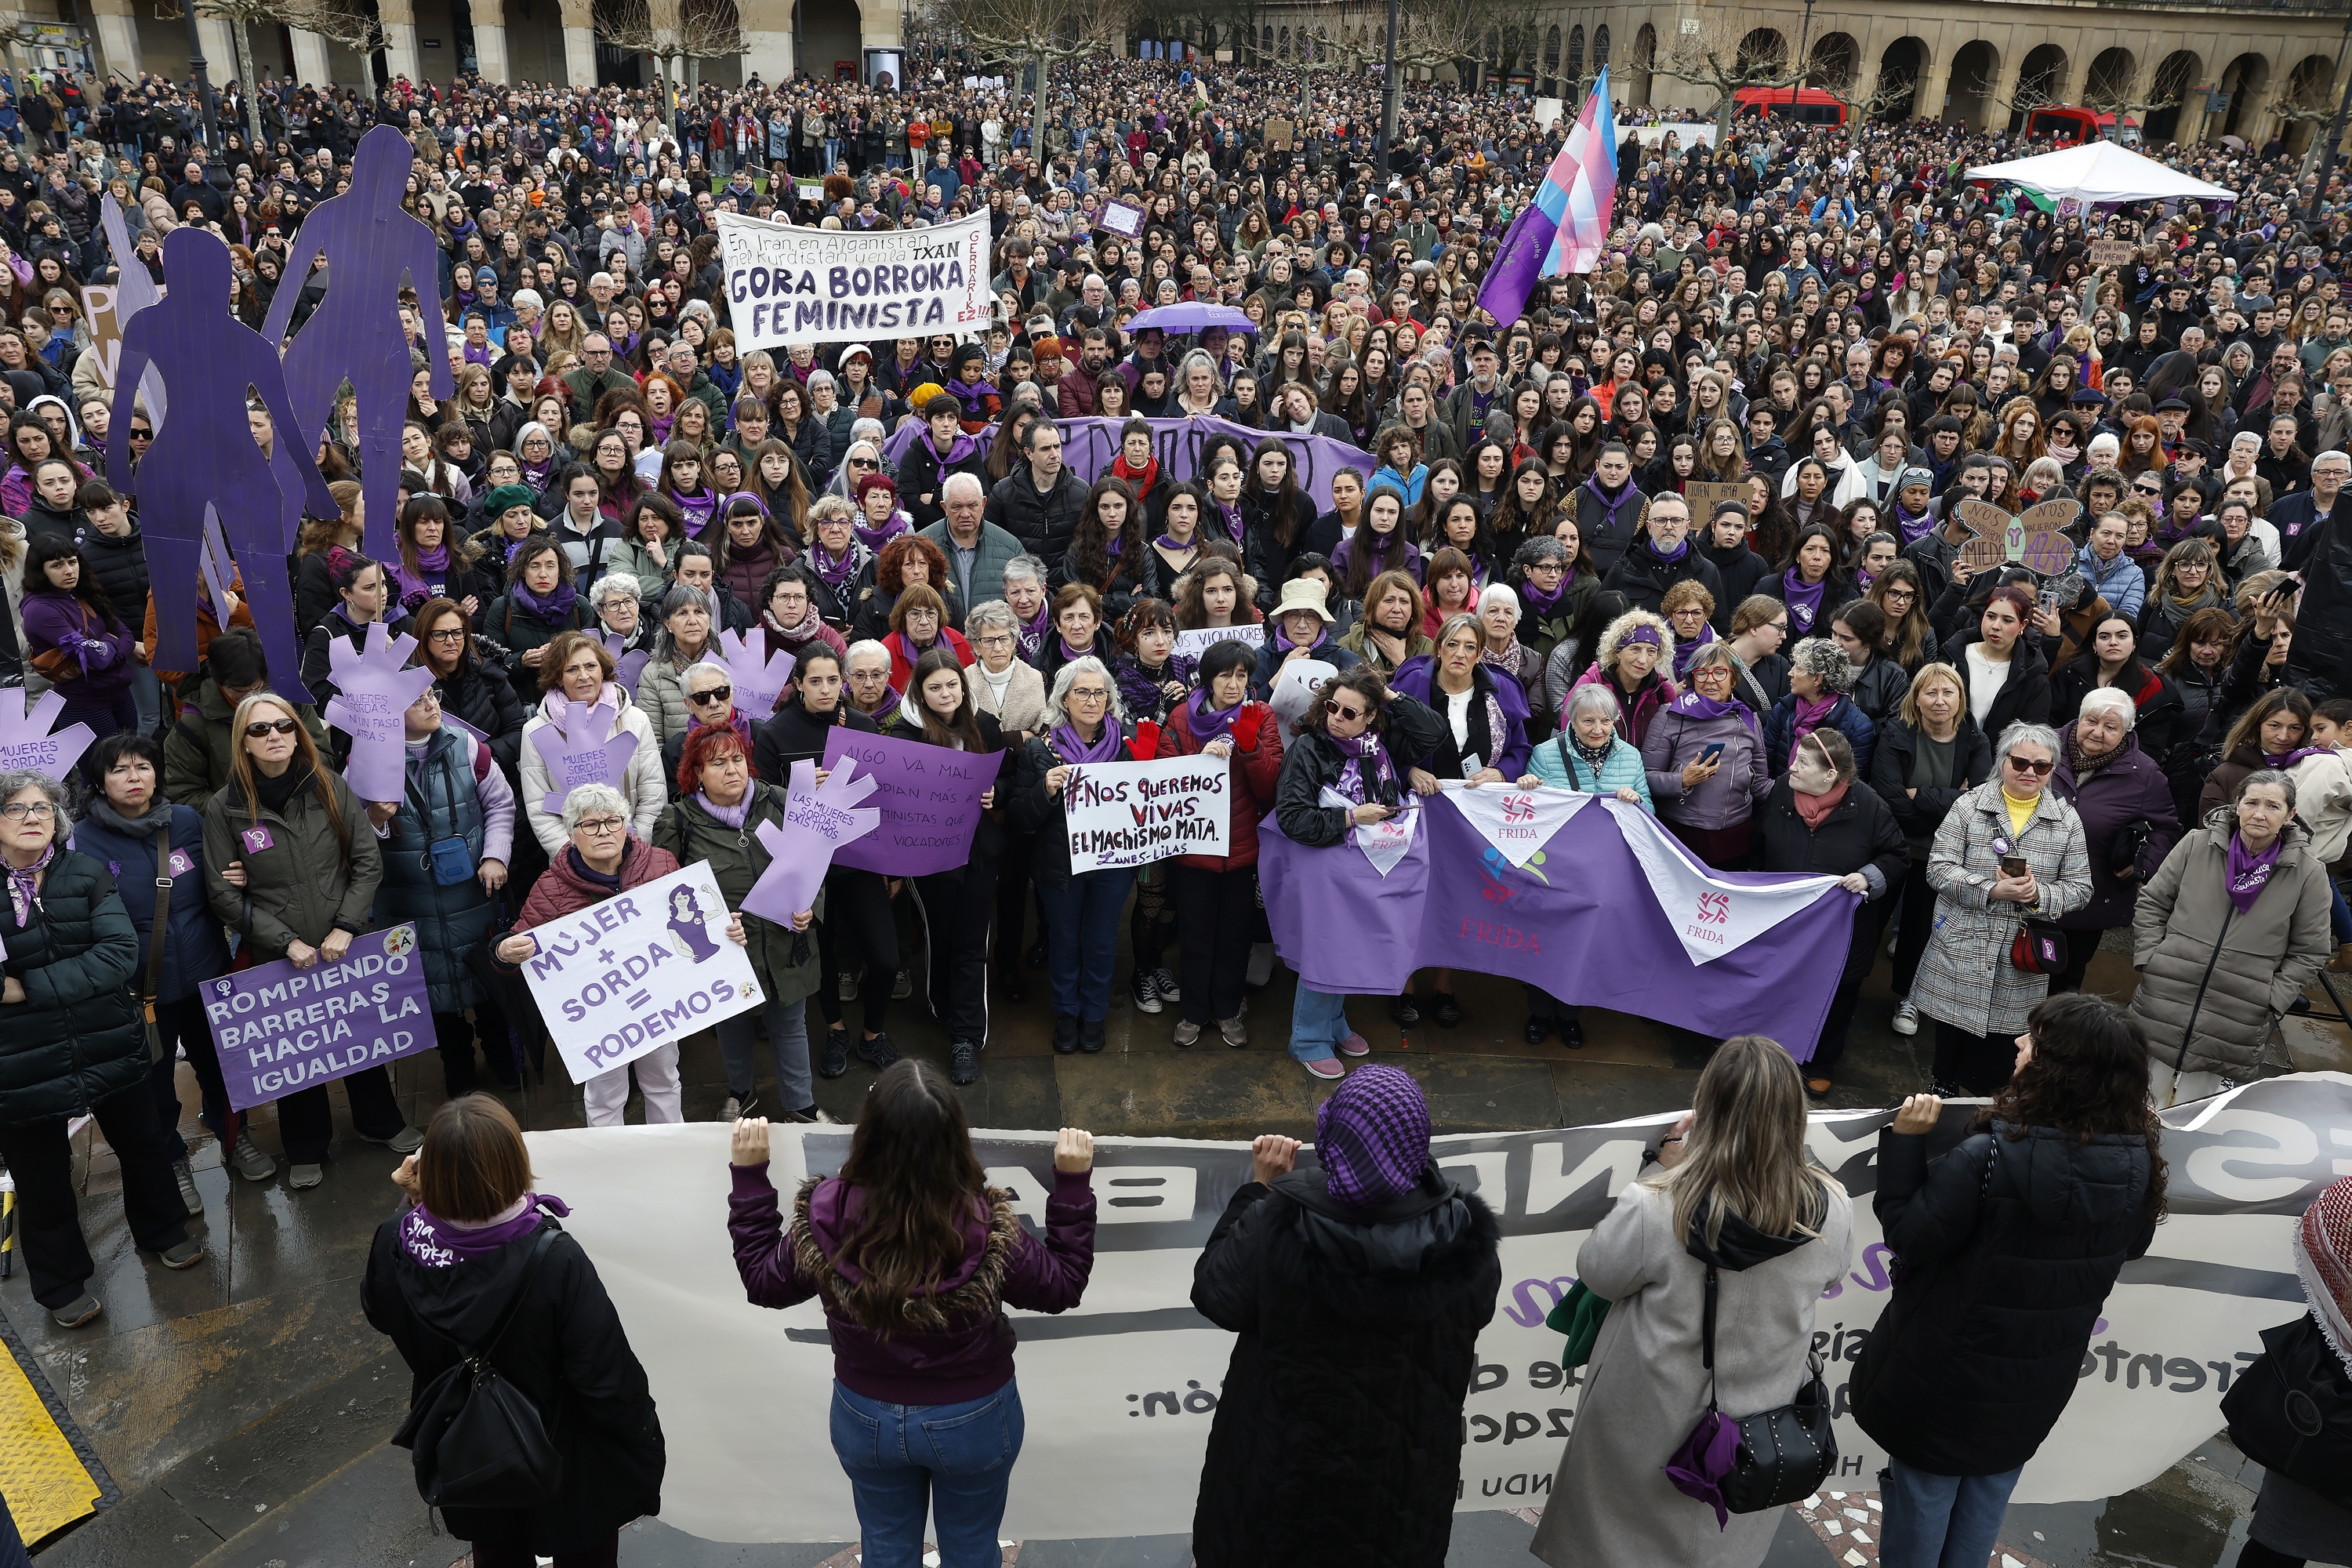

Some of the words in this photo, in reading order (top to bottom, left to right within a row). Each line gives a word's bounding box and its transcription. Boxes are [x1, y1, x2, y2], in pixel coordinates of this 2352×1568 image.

[1269, 122, 1288, 130] CONTRA
[729, 234, 748, 251] En
[799, 238, 818, 250] en
[2094, 242, 2111, 253] NON
[2114, 243, 2131, 252] UNA
[757, 248, 848, 266] Kurdistán
[913, 241, 960, 260] TXAN
[2104, 253, 2126, 263] MENO
[732, 266, 816, 303] GORA
[829, 260, 965, 299] BORROKA
[753, 296, 945, 338] FEMINISTA
[1688, 484, 1709, 499] QUIEN
[1721, 485, 1737, 497] AMA
[1689, 499, 1697, 508] NO
[2036, 503, 2067, 517] NOS
[1968, 503, 2002, 527] NOS
[1966, 517, 2005, 543] SEMBRARON
[2024, 521, 2061, 533] NACIERON
[2007, 528, 2023, 547] Y
[1965, 541, 2006, 567] MIEDO
[2023, 532, 2073, 575] ALAS
[1178, 633, 1190, 648] OS
[346, 692, 388, 705] MUJERES
[733, 684, 755, 699] STRA
[349, 702, 390, 715] SORDAS,
[358, 717, 369, 728] UN
[373, 718, 400, 728] PASO
[357, 729, 386, 742] ATRAS
[1210, 733, 1232, 742] ALESTINA
[0, 740, 59, 757] MUJERES
[562, 749, 607, 765] MUJERES
[2, 753, 56, 770] SORDAS
[568, 760, 608, 775] SORDAS
[844, 746, 886, 764] ALGO
[902, 757, 926, 774] VA
[938, 764, 974, 779] MAL
[566, 770, 609, 786] EXISTEN
[1138, 772, 1226, 802] QUEREMOS
[930, 789, 956, 804] MÁS
[965, 794, 973, 803] A
[793, 792, 812, 808] LAS
[814, 801, 855, 826] MUJERES
[800, 806, 837, 829] SORDAS
[866, 806, 937, 824] MINISTAS
[945, 814, 966, 828] QUE
[787, 811, 839, 840] EXISTIMOS
[1497, 828, 1538, 840] FRIDA
[862, 830, 879, 841] OS
[1370, 837, 1408, 851] FRIDA
[1458, 916, 1541, 955] FRIDA
[1686, 924, 1724, 945] FRIDA
[207, 954, 408, 1025] ROMPIENDO
[561, 942, 673, 1022] SORDA
[220, 982, 390, 1050] BARRERAS
[583, 979, 735, 1069] PODEMOS
[248, 1019, 353, 1068] HACIA
[378, 996, 422, 1024] LA
[252, 1031, 414, 1095] IGUALDAD
